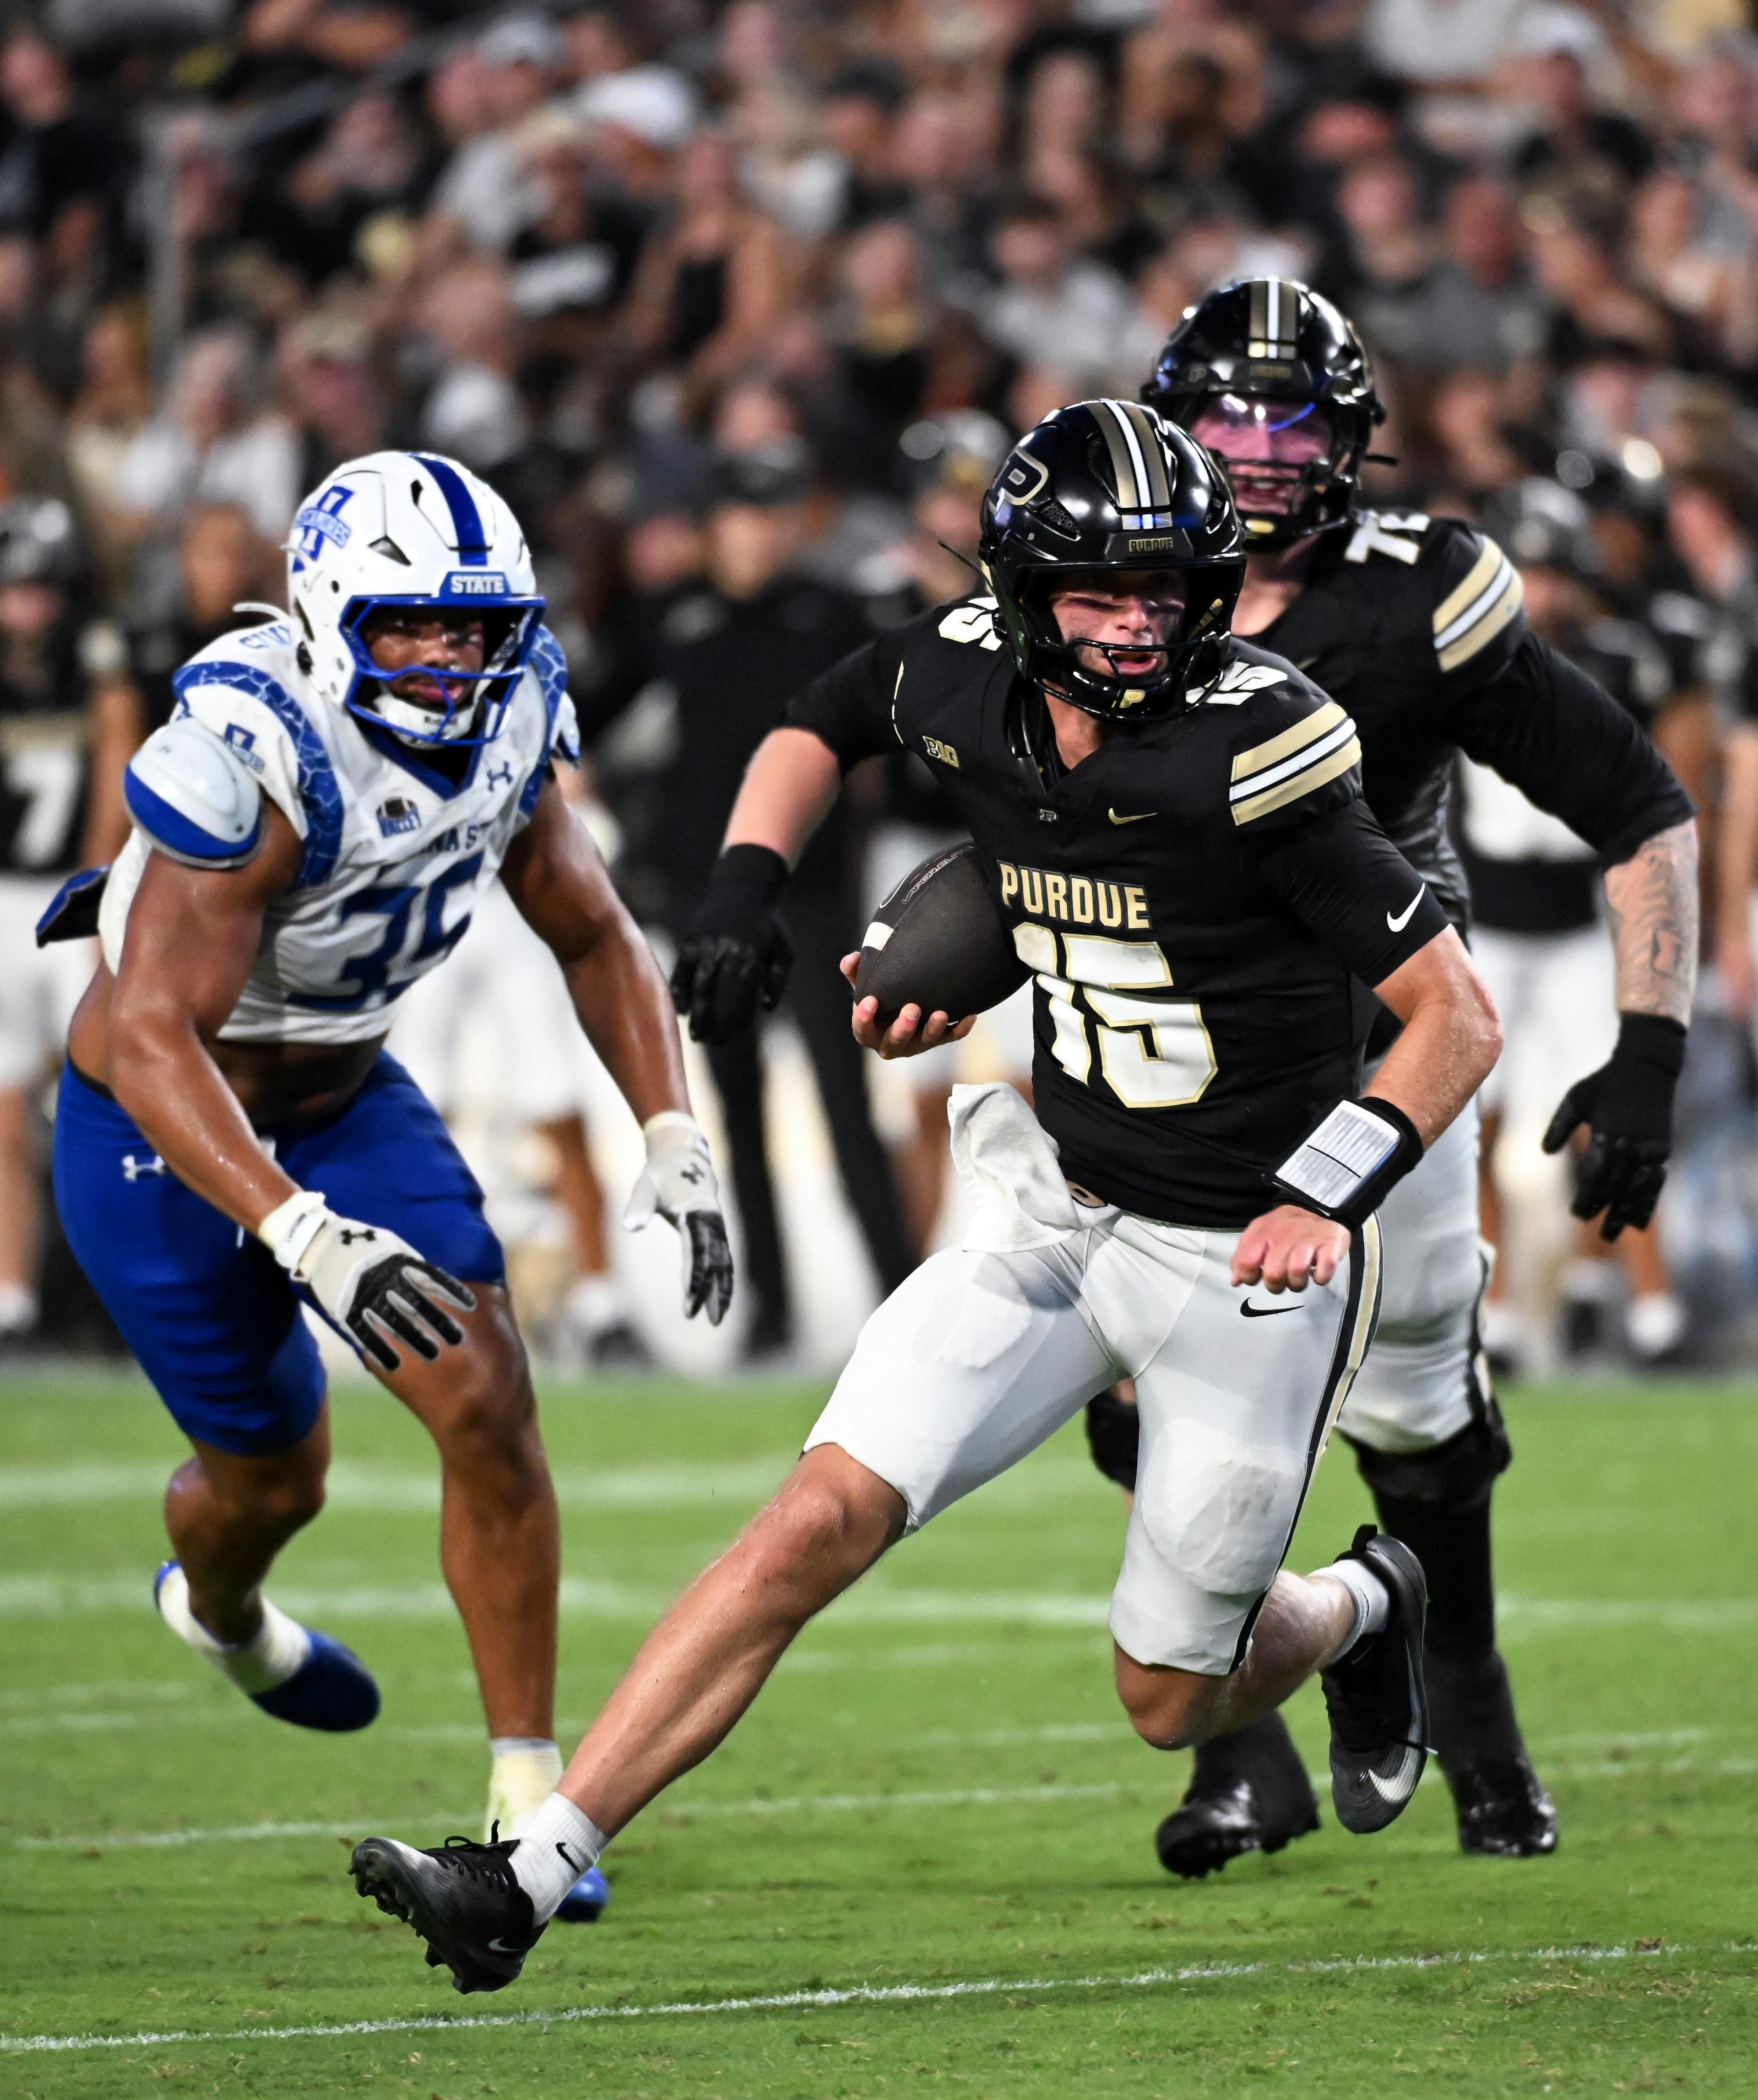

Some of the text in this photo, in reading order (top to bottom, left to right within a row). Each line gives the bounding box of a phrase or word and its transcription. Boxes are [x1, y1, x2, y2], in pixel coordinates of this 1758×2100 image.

[988, 447, 1049, 515] P
[1129, 537, 1173, 552] PURDUE
[451, 575, 504, 594] STATE
[8, 747, 85, 866] 7
[901, 868, 939, 905] VAPOR
[998, 860, 1152, 930] PURDUE
[1012, 922, 1219, 1108] 15
